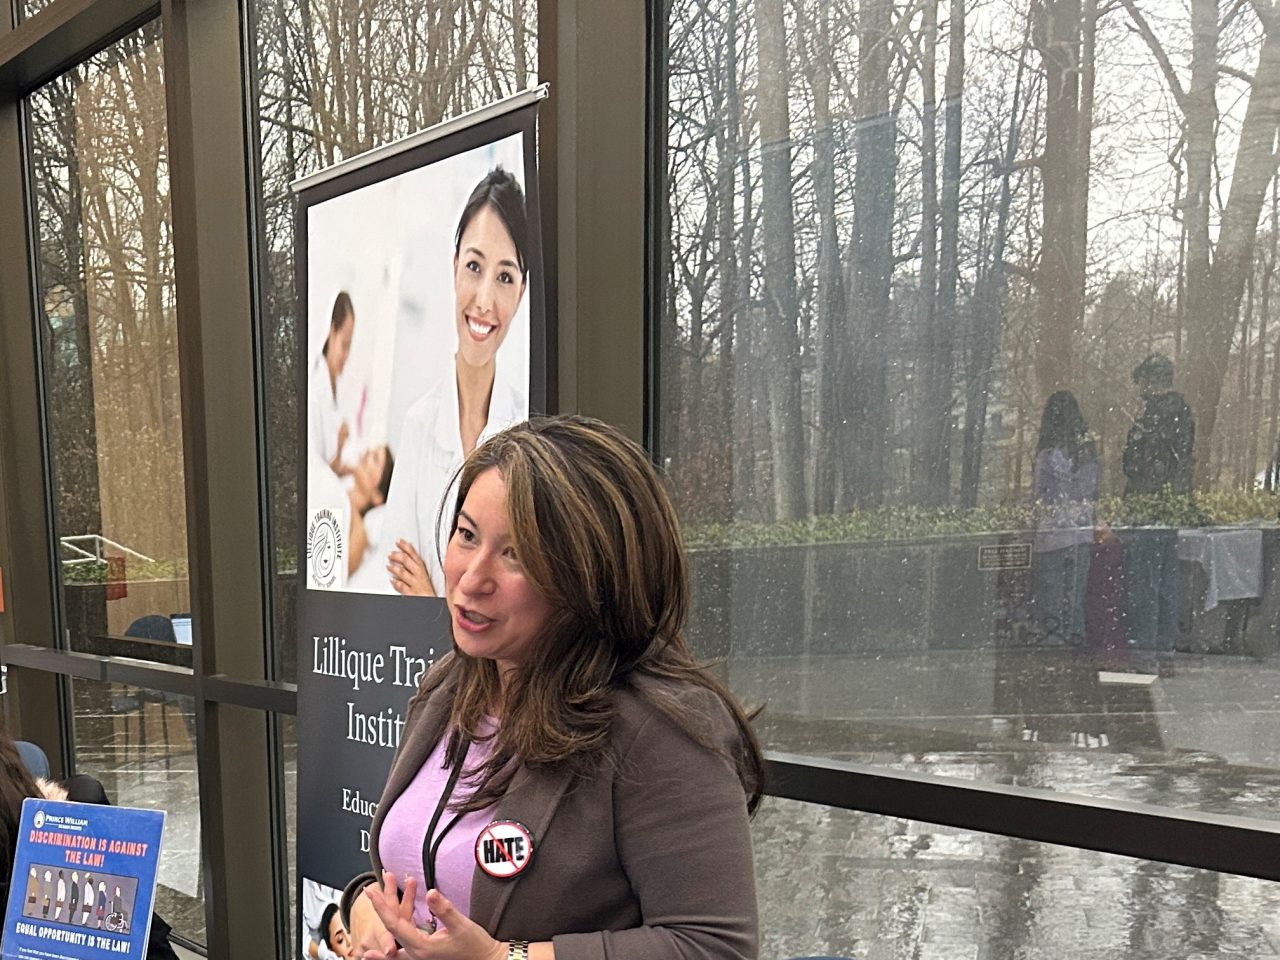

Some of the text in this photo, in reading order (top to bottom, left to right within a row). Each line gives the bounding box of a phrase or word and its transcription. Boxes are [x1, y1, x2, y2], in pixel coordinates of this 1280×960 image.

[312, 636, 384, 690] Lillique
[342, 788, 380, 818] Educ
[29, 830, 148, 857] DISCRIMINATION IS AGAINST
[483, 837, 524, 864] HATE
[65, 850, 105, 868] THE LAW!
[15, 922, 131, 954] EQUAL OPPORTUNITY IS THE LAW!
